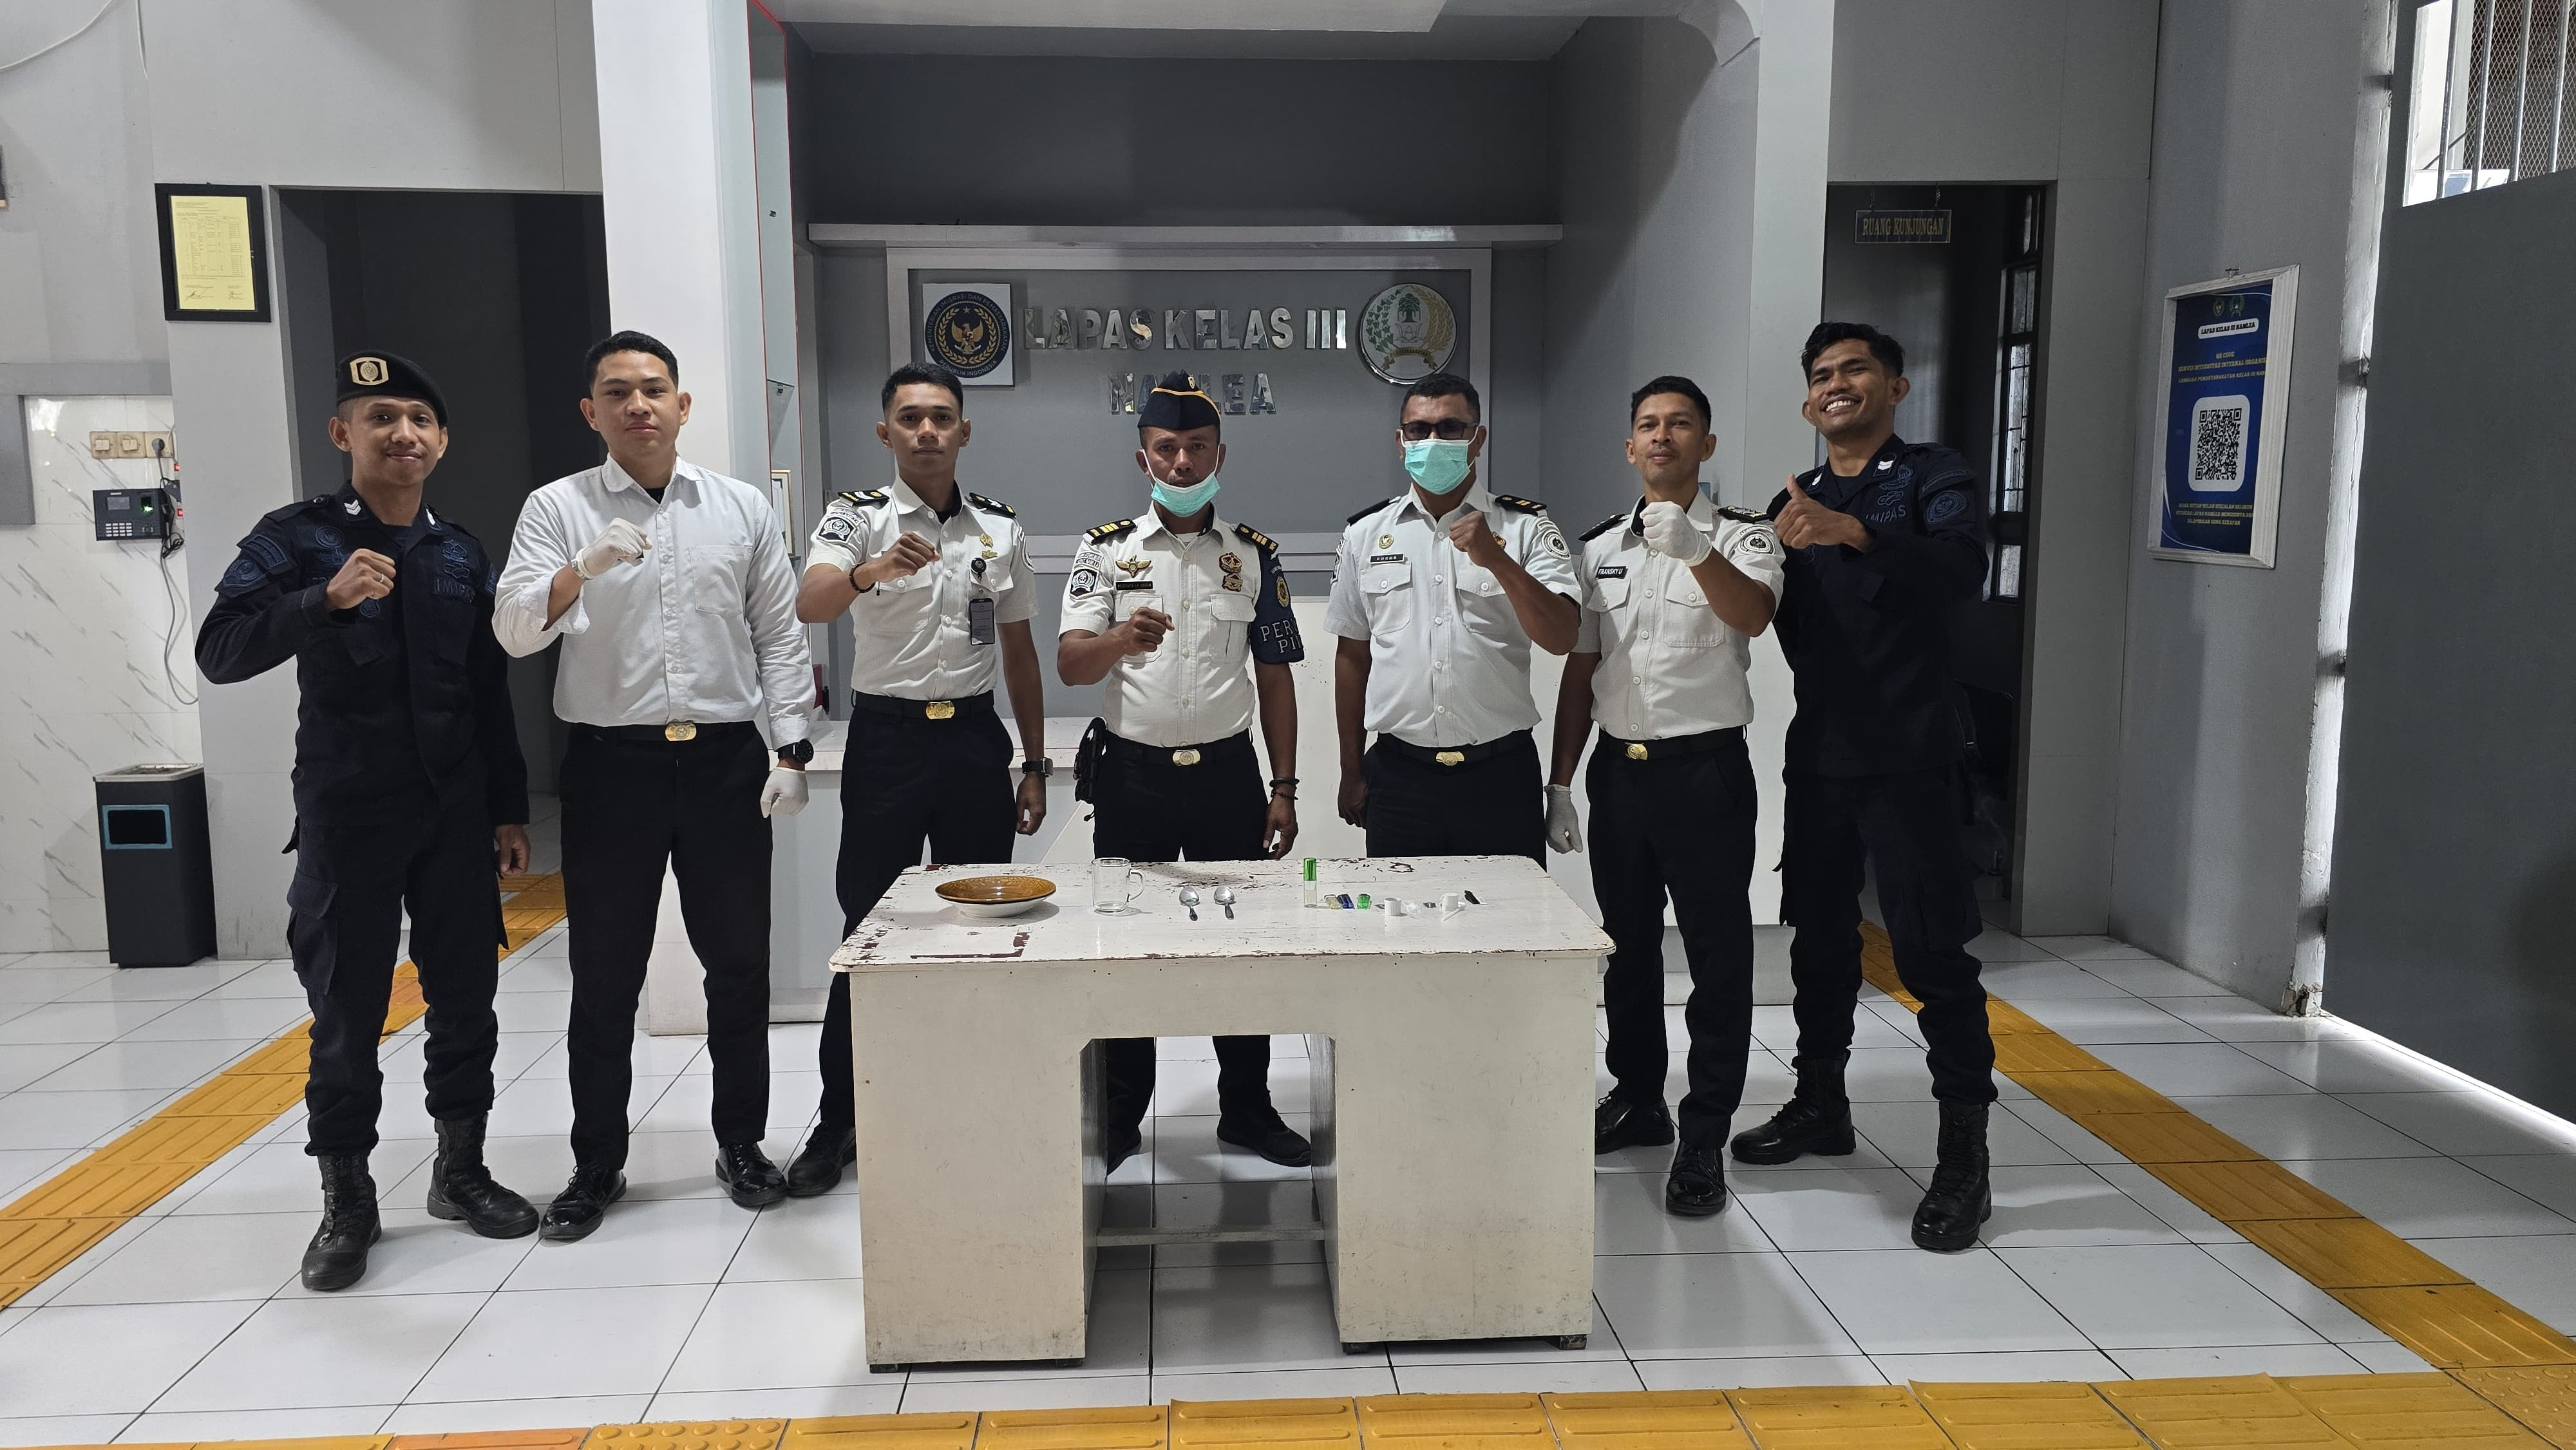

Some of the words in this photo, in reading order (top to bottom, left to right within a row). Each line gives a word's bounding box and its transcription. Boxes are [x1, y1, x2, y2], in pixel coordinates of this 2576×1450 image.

[1862, 218, 1891, 236] RUANG
[1893, 218, 1944, 236] KUNJUNGAN
[1025, 308, 1153, 350] LAPAS
[1165, 308, 1293, 350] KELAS
[1307, 310, 1347, 349] III
[2236, 322, 2255, 330] NAMLEA
[967, 360, 998, 376] INDONESIA
[1110, 373, 1276, 415] NAEA
